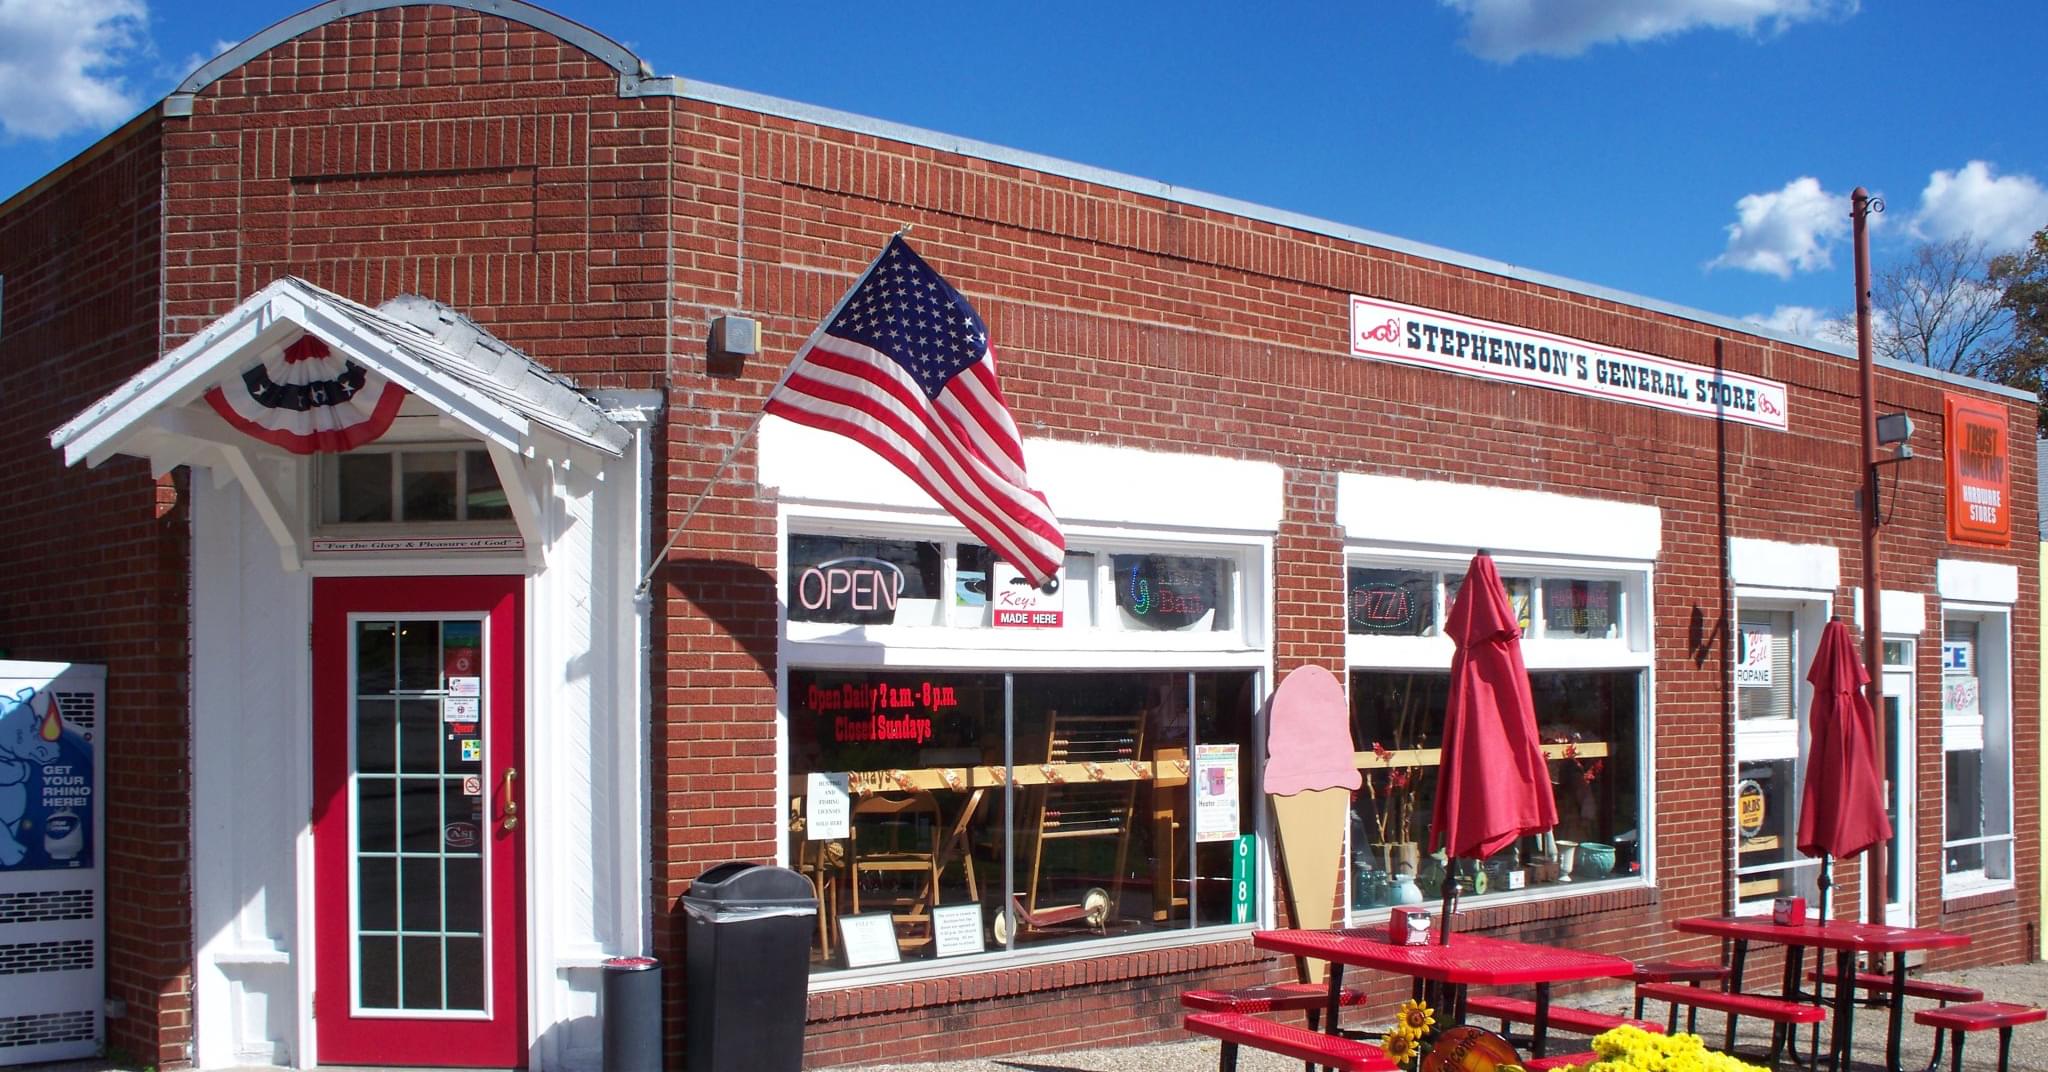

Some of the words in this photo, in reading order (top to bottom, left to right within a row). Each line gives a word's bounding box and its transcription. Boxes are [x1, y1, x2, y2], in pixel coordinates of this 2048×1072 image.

[1406, 321, 1588, 381] STEPHENSON'S
[1596, 358, 1688, 400] GENERAL
[1695, 378, 1756, 413] STORE
[1966, 422, 1998, 456] TRUST
[1959, 448, 2004, 484] WORTHY
[1962, 484, 2001, 508] HARDWARE
[1969, 504, 1997, 524] STORES
[799, 568, 898, 611] OPEN
[999, 591, 1037, 609] Keys
[1354, 590, 1409, 620] PIZZA
[1001, 613, 1028, 624] MADE
[1033, 613, 1058, 625] HERE
[1749, 645, 1767, 666] Sell
[1737, 669, 1769, 682] ROPANE
[808, 683, 841, 715] Open
[843, 683, 877, 713] Daily
[923, 682, 931, 707] 8
[932, 686, 957, 711] p.m.
[835, 715, 876, 741] Closed
[878, 714, 932, 744] Sundays
[43, 766, 73, 775] GET
[43, 776, 85, 785] YOUR
[43, 787, 91, 796] RHINO
[43, 797, 88, 807] HERE!
